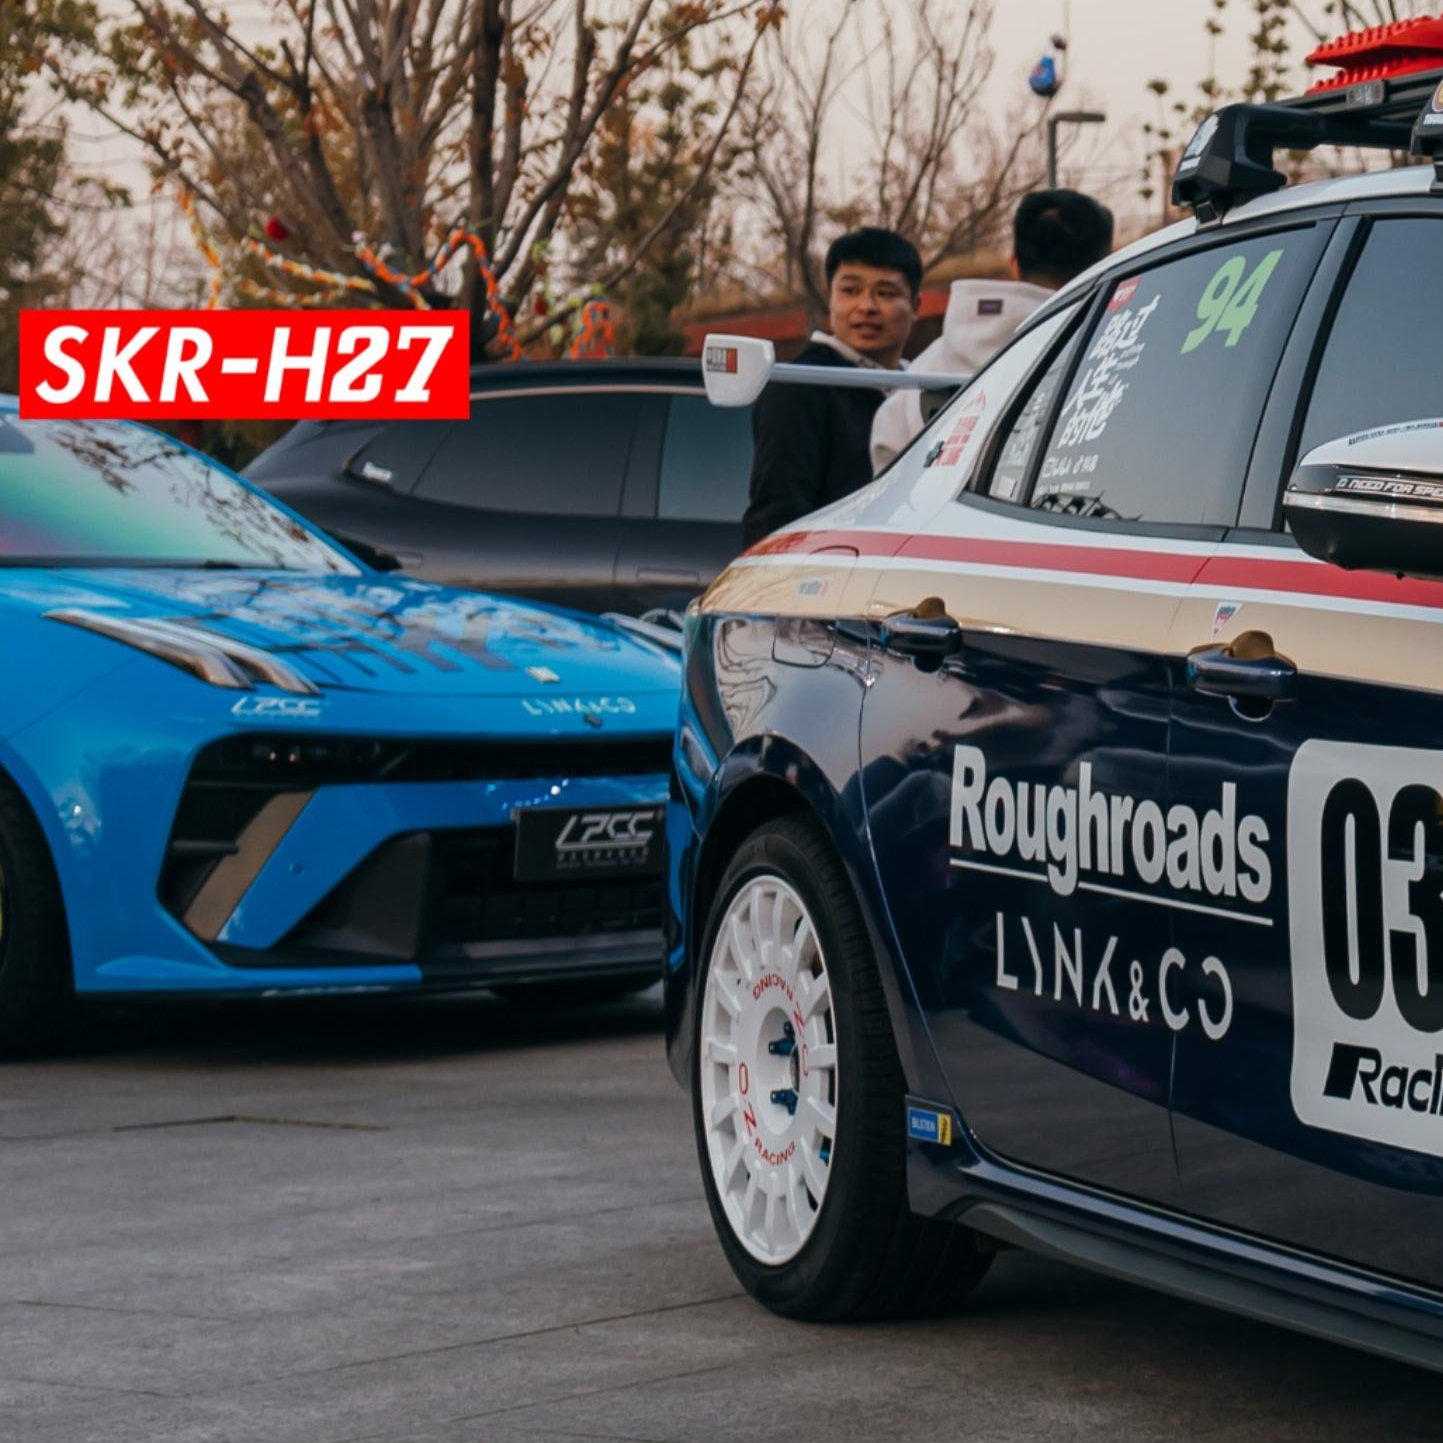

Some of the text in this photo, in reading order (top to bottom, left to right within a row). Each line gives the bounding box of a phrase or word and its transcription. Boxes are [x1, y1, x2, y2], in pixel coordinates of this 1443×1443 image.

[1180, 249, 1284, 355] 94
[1384, 482, 1413, 493] FOR
[950, 744, 1273, 903] Roughroads
